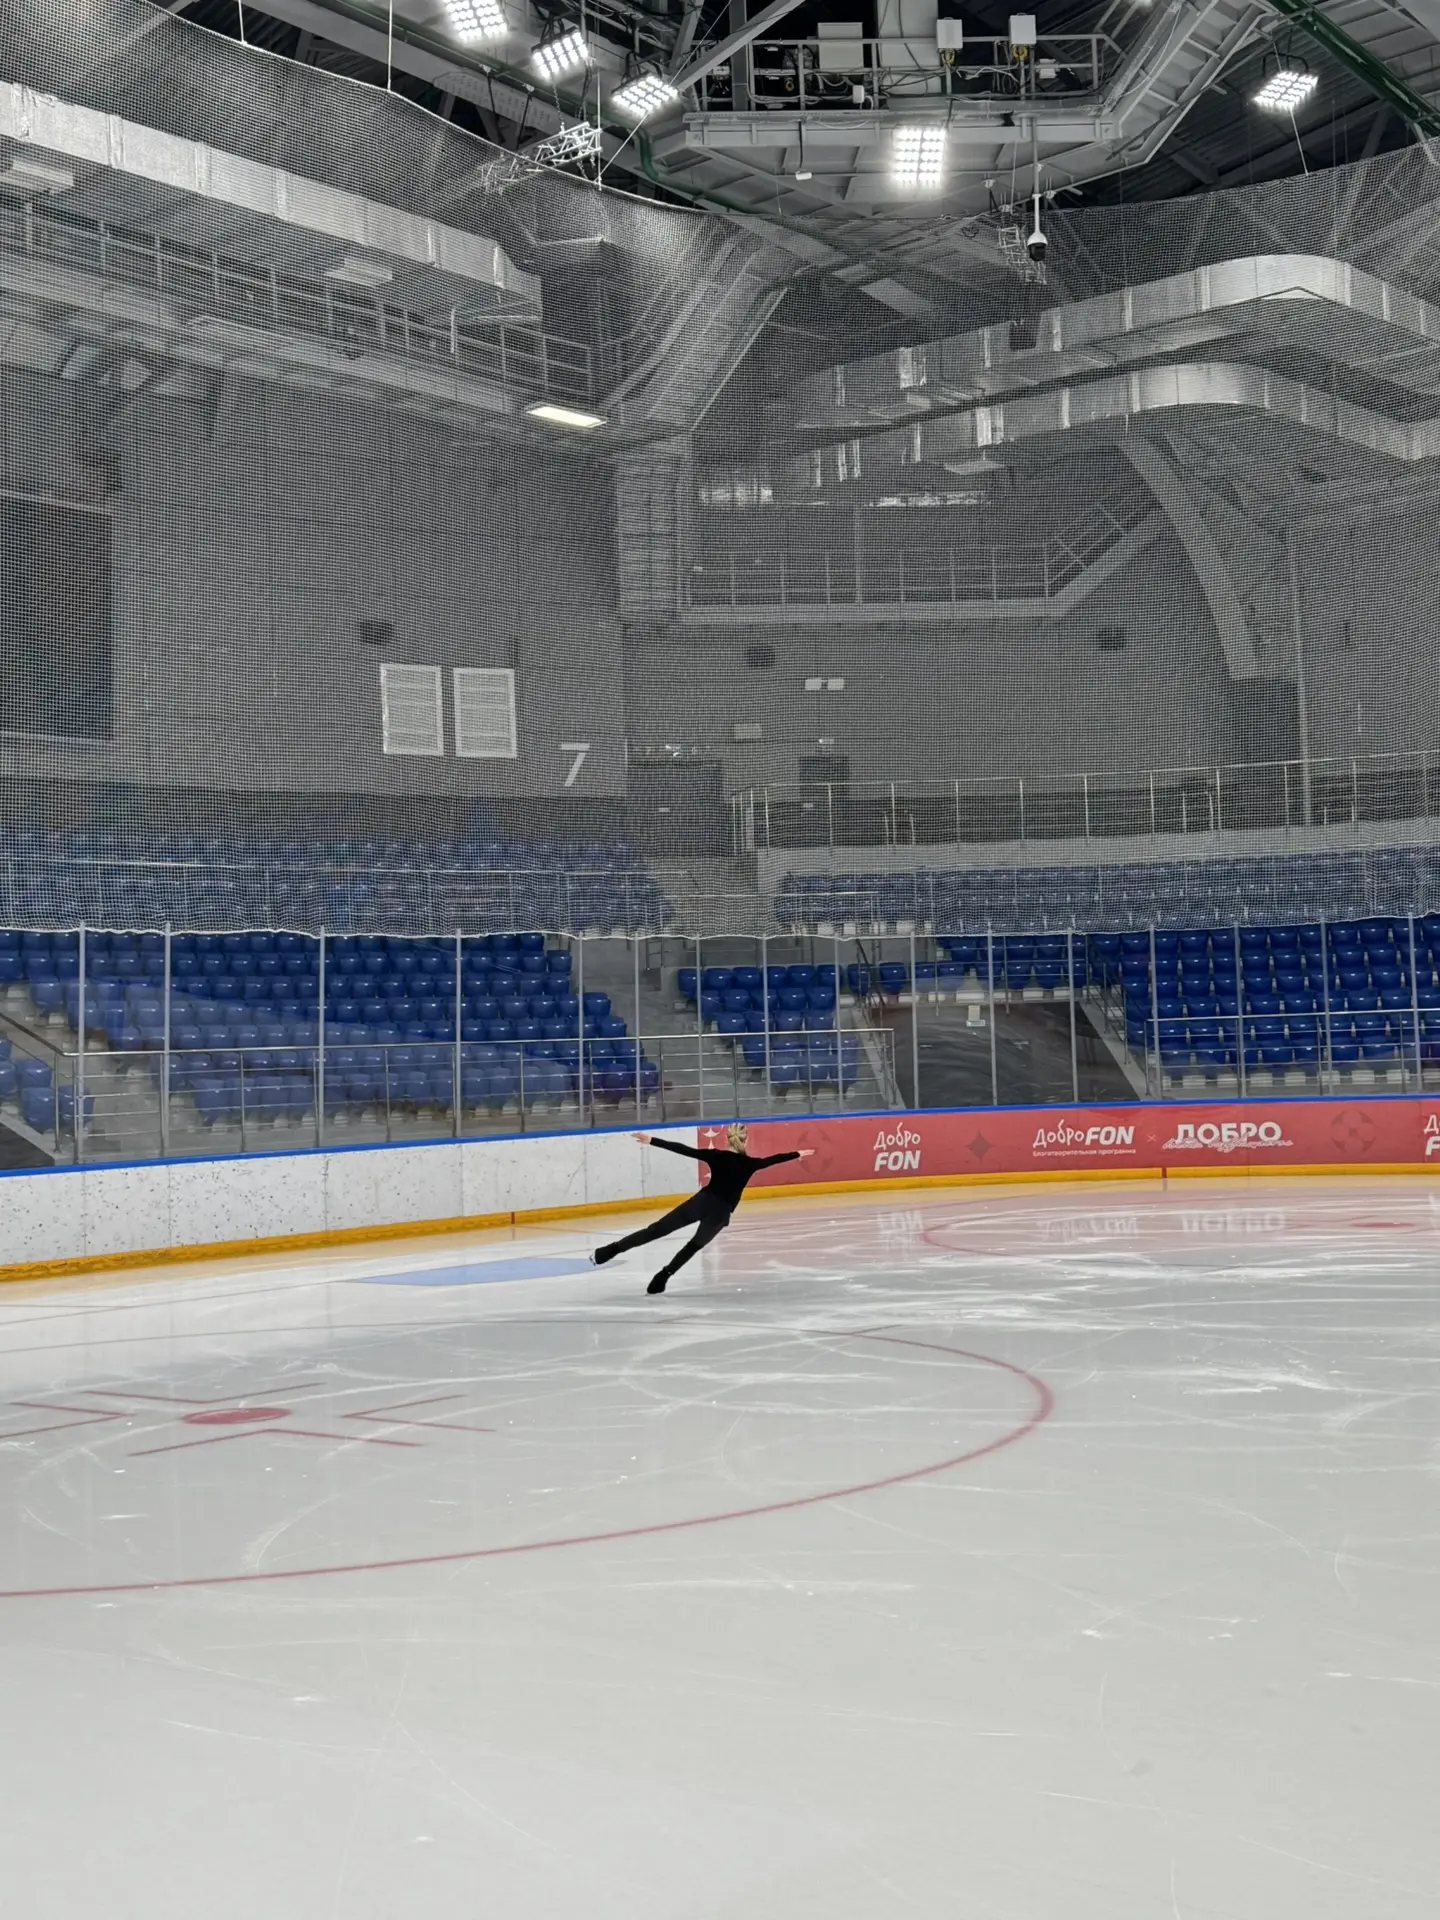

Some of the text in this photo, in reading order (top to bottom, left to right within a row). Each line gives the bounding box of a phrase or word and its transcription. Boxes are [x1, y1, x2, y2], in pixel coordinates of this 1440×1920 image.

[561, 742, 590, 787] 7
[873, 1122, 921, 1151] Добро
[874, 1150, 921, 1172] FON
